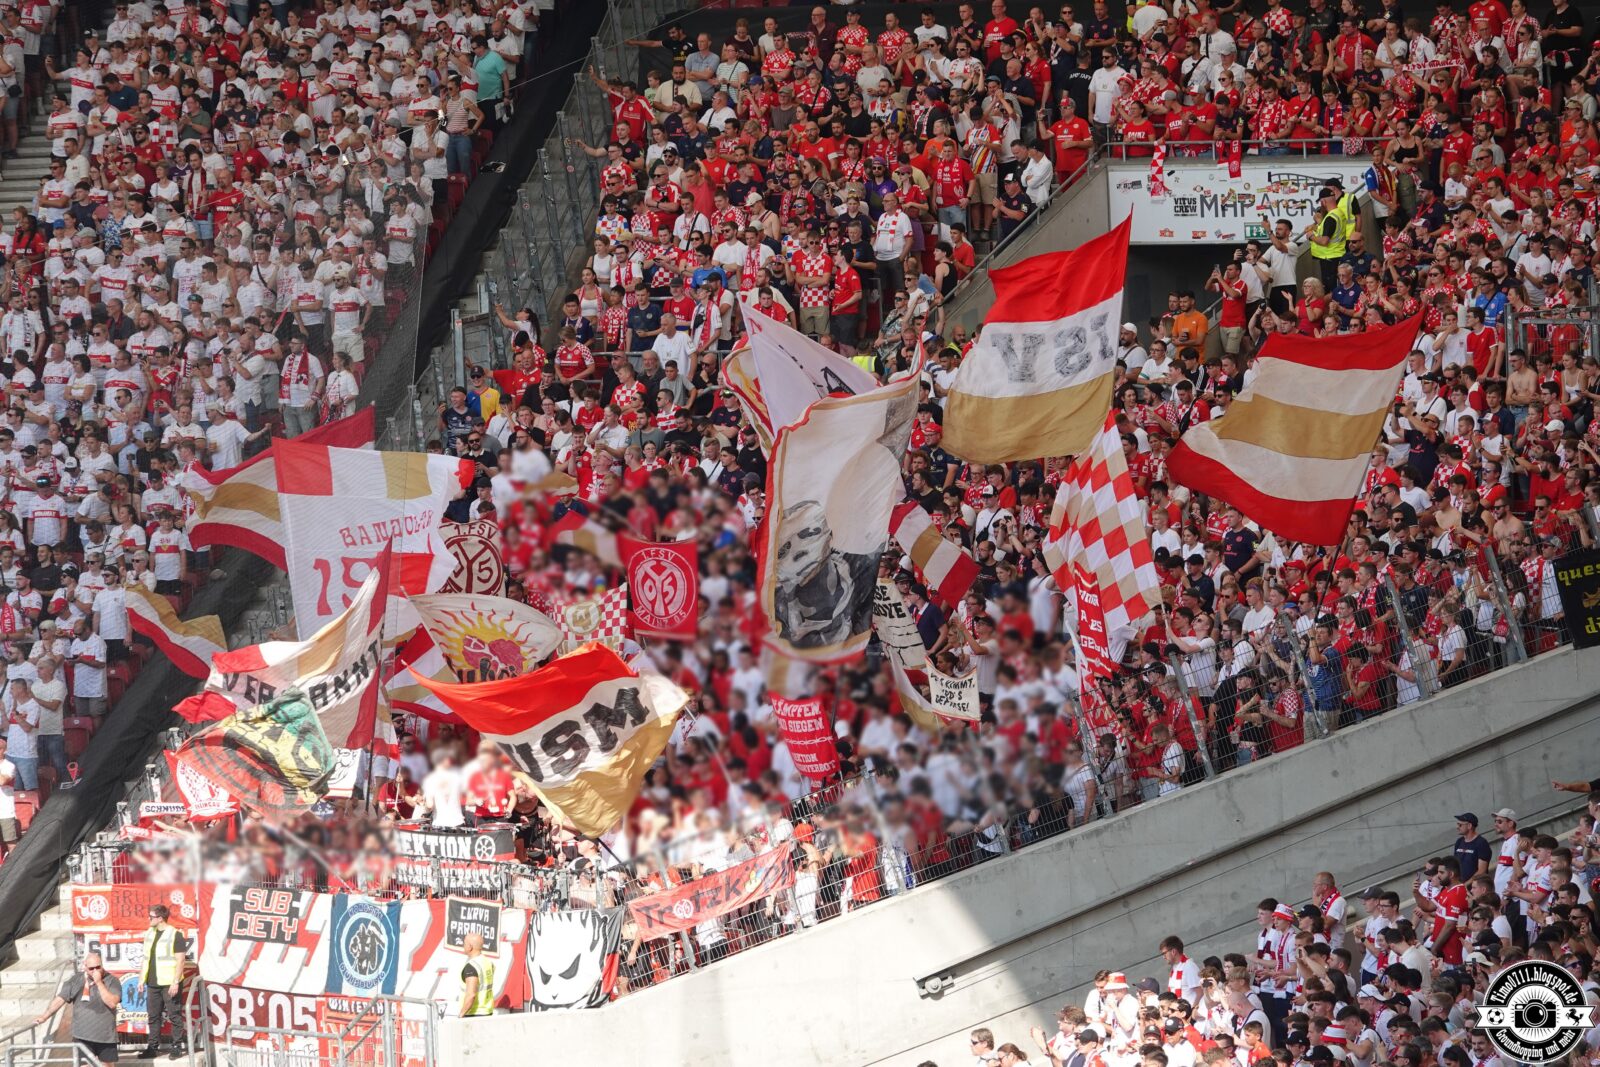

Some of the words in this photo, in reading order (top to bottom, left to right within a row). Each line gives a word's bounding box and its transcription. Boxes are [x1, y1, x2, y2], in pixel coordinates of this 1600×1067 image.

[1200, 193, 1256, 218] MHP
[244, 888, 292, 914] SUB
[460, 906, 490, 923] CURVA
